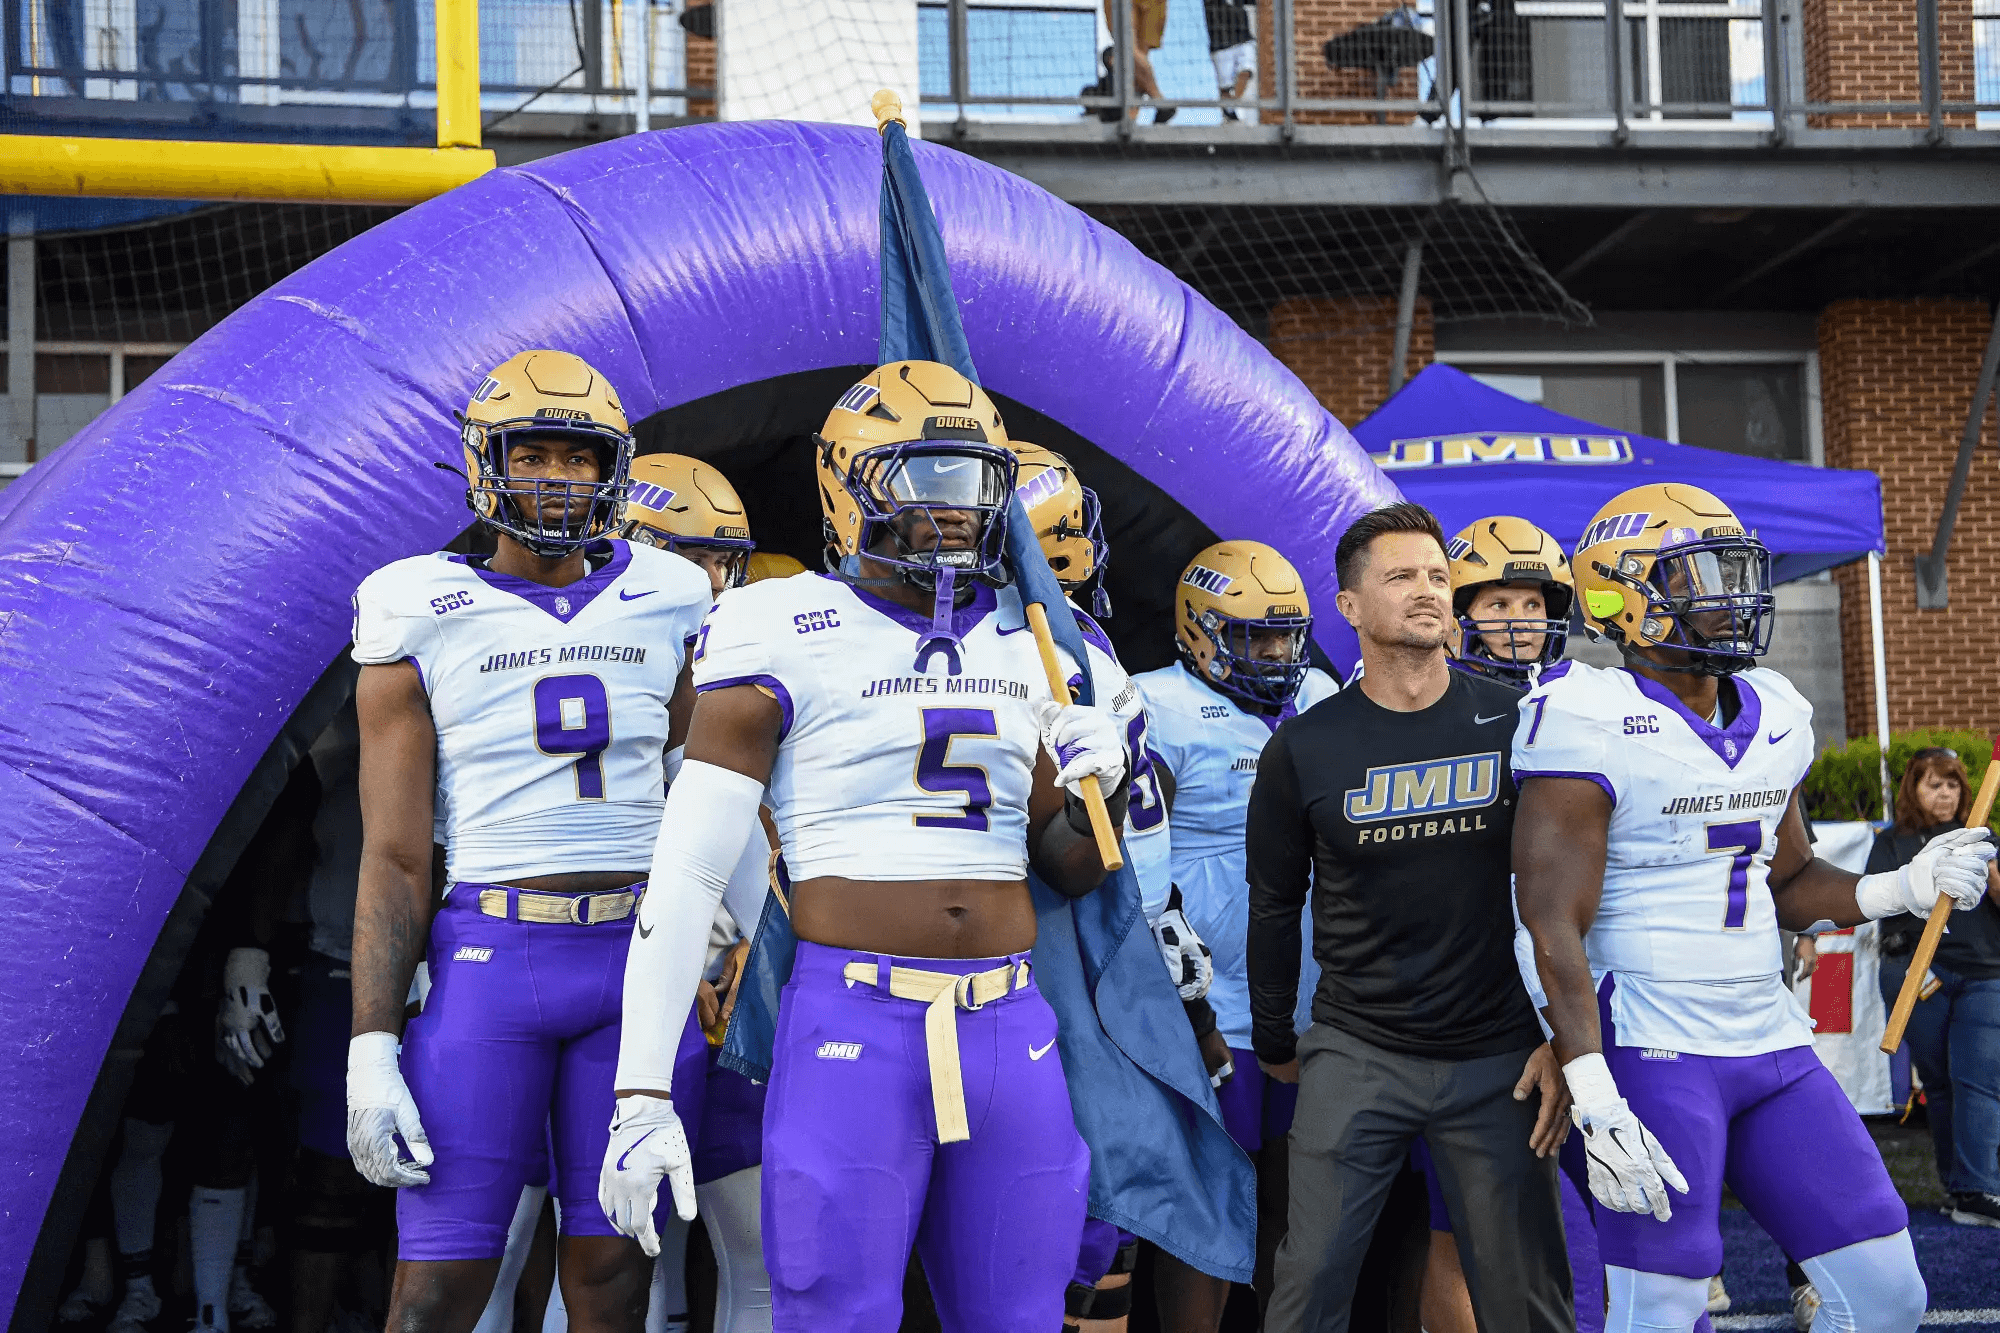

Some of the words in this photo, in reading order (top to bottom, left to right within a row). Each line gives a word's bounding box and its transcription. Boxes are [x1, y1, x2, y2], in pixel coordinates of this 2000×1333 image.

[544, 408, 586, 420] DUKES
[935, 416, 978, 430] DUKES
[1372, 434, 1632, 468] JMU
[628, 478, 677, 512] MU
[1016, 467, 1064, 508] MU
[724, 527, 748, 538] DUKES
[1577, 512, 1652, 556] JMU
[1711, 526, 1744, 537] DUKES
[935, 555, 967, 565] Riddell
[1513, 561, 1545, 571] DUKES
[1183, 565, 1233, 596] JMU
[430, 590, 474, 616] SBC
[1273, 605, 1299, 615] DUKES
[793, 608, 841, 634] SBC
[480, 648, 552, 674] JAMES
[558, 645, 646, 664] MADISON
[862, 678, 938, 699] JAMES
[946, 678, 1029, 700] MADISON
[1201, 705, 1230, 719] SBC
[1623, 715, 1660, 735] SBC
[531, 672, 613, 802] 9
[912, 705, 1001, 833] 5
[1231, 758, 1258, 771] JAM
[1348, 755, 1498, 821] JMU
[1661, 795, 1723, 815] JAMES
[1728, 789, 1788, 811] MADISON
[1358, 815, 1487, 845] FOOTBALL
[1704, 817, 1764, 932] 7
[454, 947, 494, 962] JMU
[818, 1042, 863, 1059] JMU
